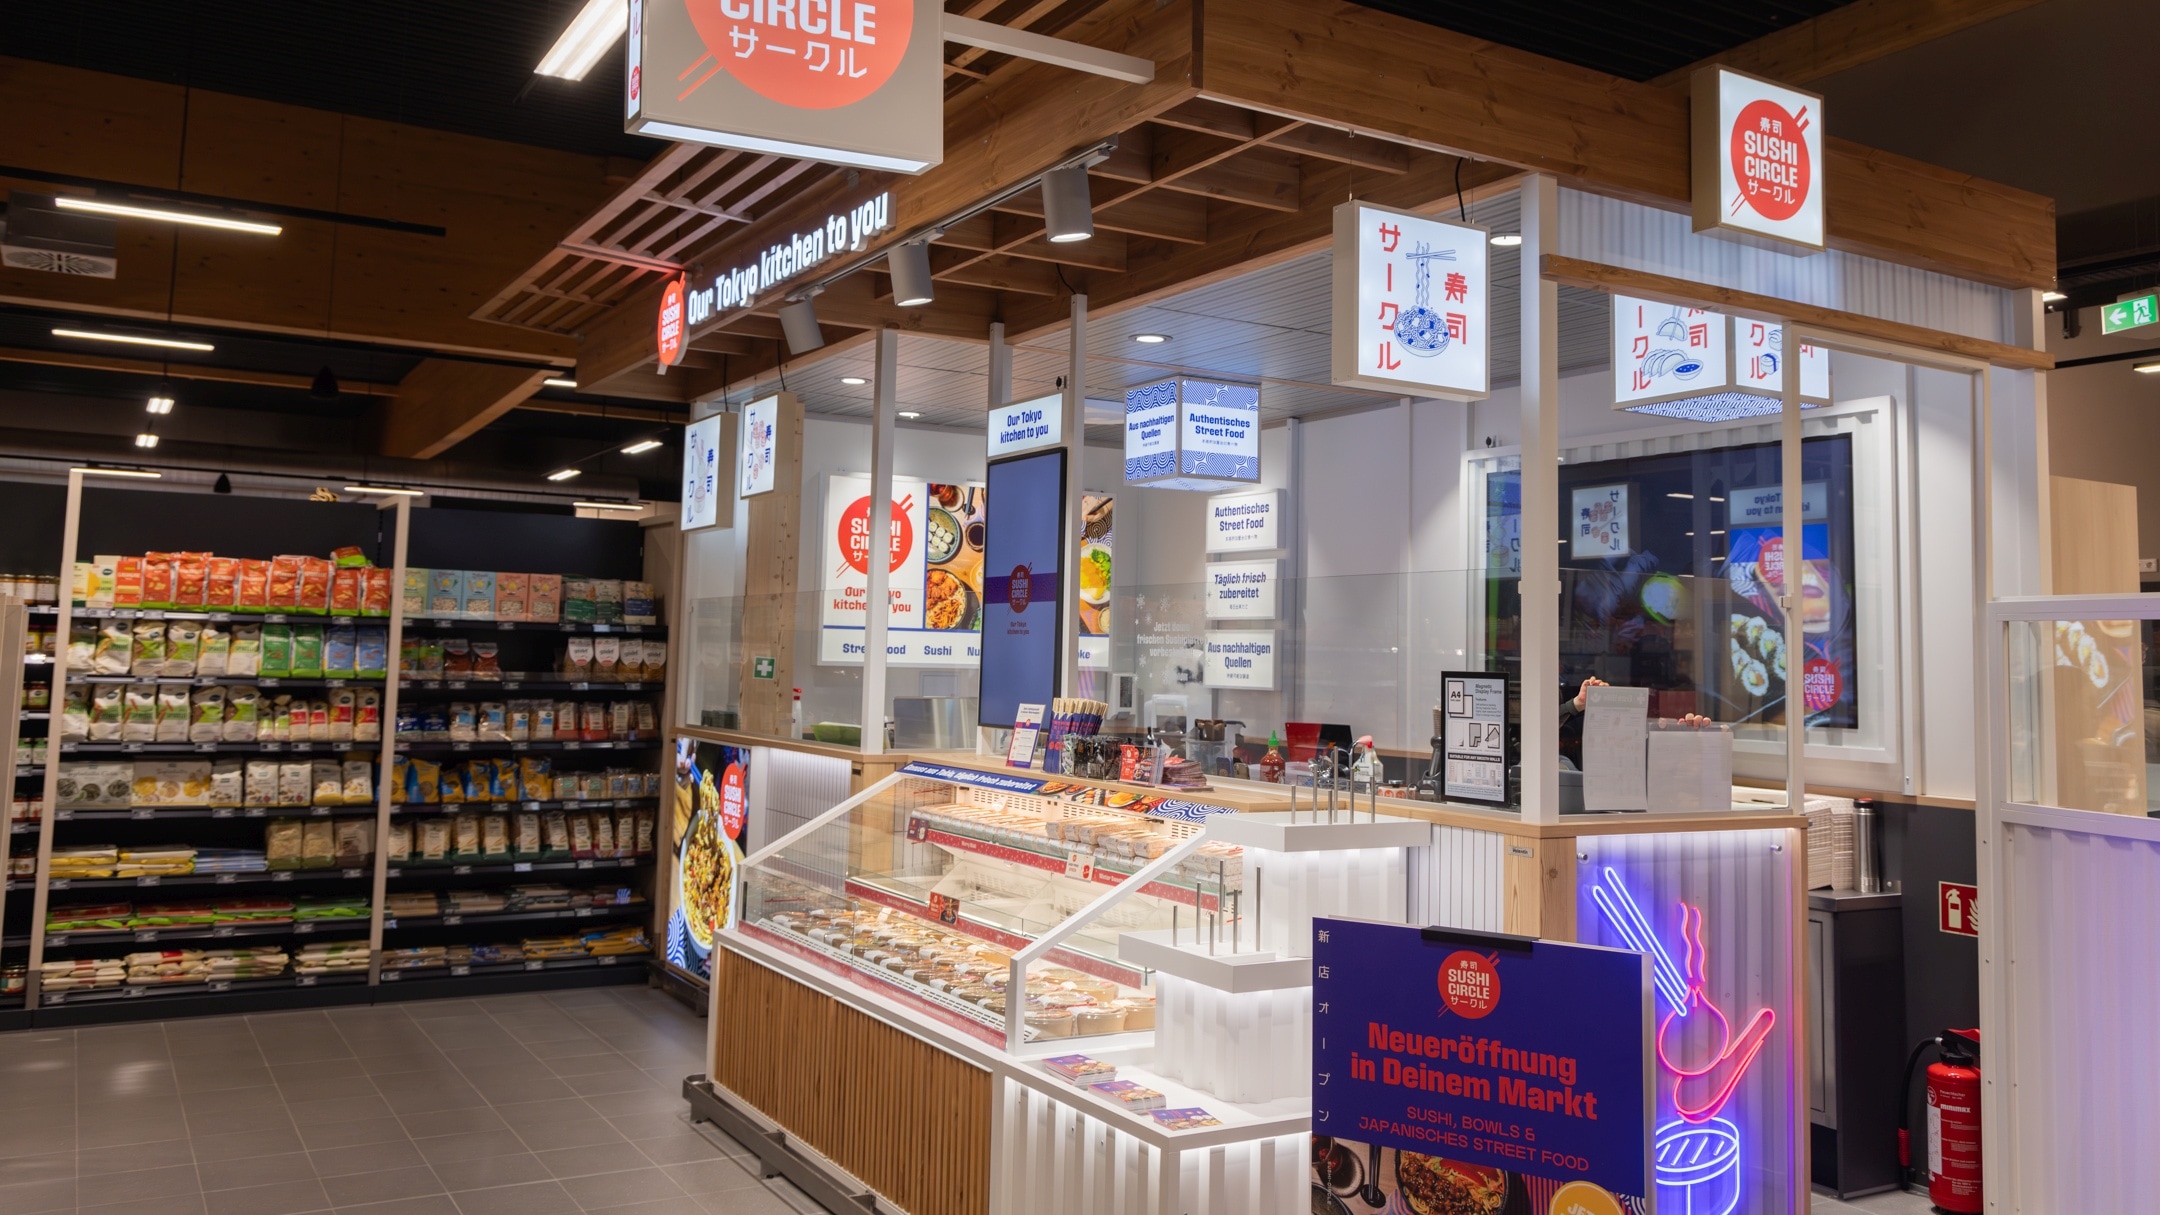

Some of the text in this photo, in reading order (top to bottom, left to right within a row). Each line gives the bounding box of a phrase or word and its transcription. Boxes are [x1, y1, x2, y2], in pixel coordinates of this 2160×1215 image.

[721, 0, 876, 45] CIRCLE
[729, 25, 867, 78] サークル
[1760, 116, 1782, 136] 寿司
[1744, 130, 1797, 165] SUSHI
[1744, 155, 1797, 188] CIRCLE
[1748, 179, 1795, 205] サークル
[687, 191, 889, 326] Our Tokyo kitchen to you
[1377, 222, 1401, 371] サークル
[662, 302, 680, 327] SUSHI
[1444, 272, 1468, 345] 寿司
[661, 319, 680, 342] CIRCLE
[1687, 308, 1708, 348] 司
[1632, 305, 1651, 391] ークル
[1007, 408, 1042, 428] Our Tokyo
[1128, 413, 1175, 431] Aus nachhaltigen
[1189, 413, 1250, 428] Authentisches
[1000, 423, 1049, 444] kitchen to you
[1141, 427, 1161, 440] Quellen
[1195, 425, 1245, 439] Street Food
[1214, 503, 1270, 518] Authentisches
[850, 517, 901, 537] SUHI
[1219, 517, 1264, 531] Street Food
[1011, 579, 1028, 589] SUSHI
[1214, 572, 1267, 586] Täglich frisch
[845, 586, 865, 597] Our
[1011, 589, 1028, 598] CIRCLE
[1219, 587, 1259, 599] zubereitet
[833, 598, 911, 614] kitche you
[842, 643, 866, 654] Stre
[886, 645, 906, 655] ood
[924, 645, 952, 656] Sushi
[1208, 642, 1271, 655] Aus nachhaltigen
[1224, 657, 1252, 669] Quellen
[1804, 673, 1834, 684] SUSHI
[1450, 691, 1461, 699] A4
[1804, 684, 1834, 694] CIRCLE
[724, 784, 742, 803] SUSHI
[724, 800, 741, 818] CIRCLE
[1448, 969, 1490, 987] SUSHI
[1448, 983, 1490, 1000] CIRCLE
[1450, 996, 1488, 1010] サークル
[1317, 929, 1331, 1123] 新店オープン
[1368, 1021, 1577, 1086] Neueröffnung
[1351, 1052, 1598, 1120] in Deinem Markt
[1407, 1106, 1536, 1141] SUSHI, BOWLS &
[1359, 1116, 1590, 1172] JAPANISCHES STREET FOOD
